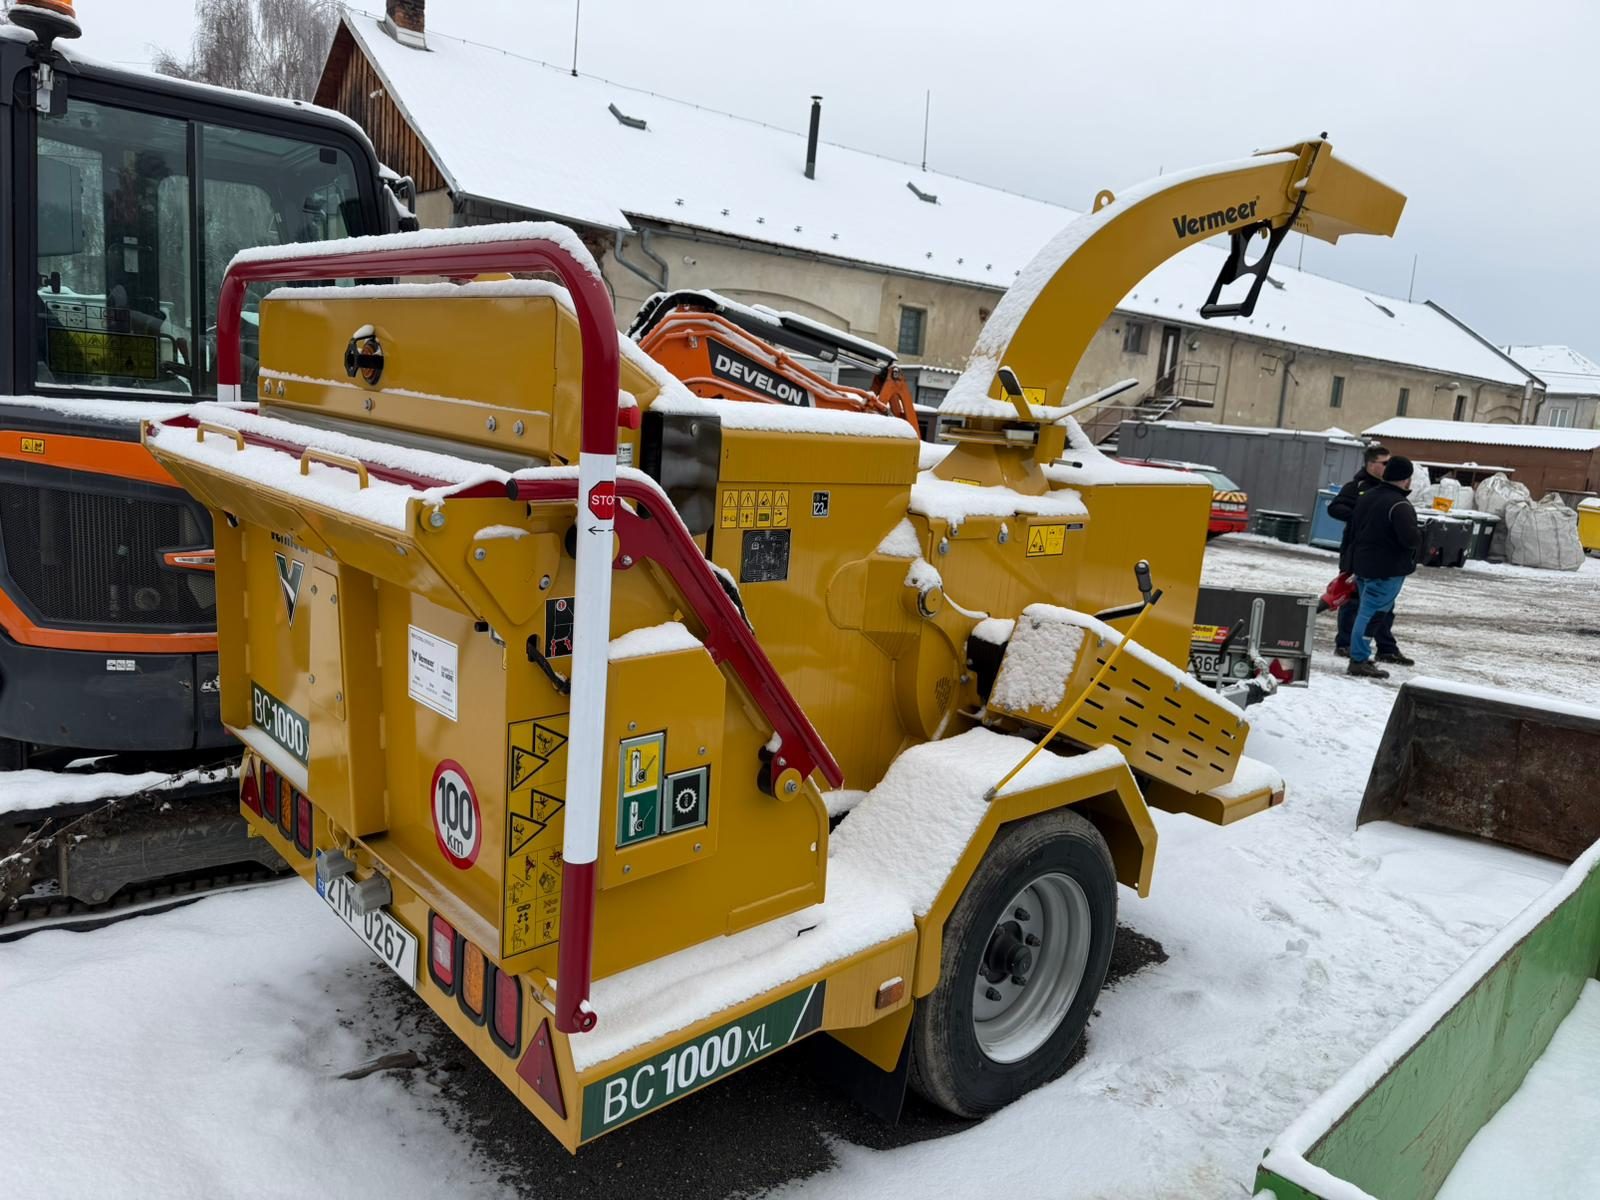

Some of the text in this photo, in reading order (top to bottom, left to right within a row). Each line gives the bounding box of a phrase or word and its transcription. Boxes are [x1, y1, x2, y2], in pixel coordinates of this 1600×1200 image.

[1172, 200, 1257, 239] Vermeer
[714, 354, 803, 405] DEVELON
[591, 494, 616, 506] STO
[254, 687, 272, 730] BC
[271, 703, 304, 757] 1000
[438, 776, 473, 840] 100
[447, 826, 464, 856] km
[603, 1023, 772, 1125] BC 1000 XL
